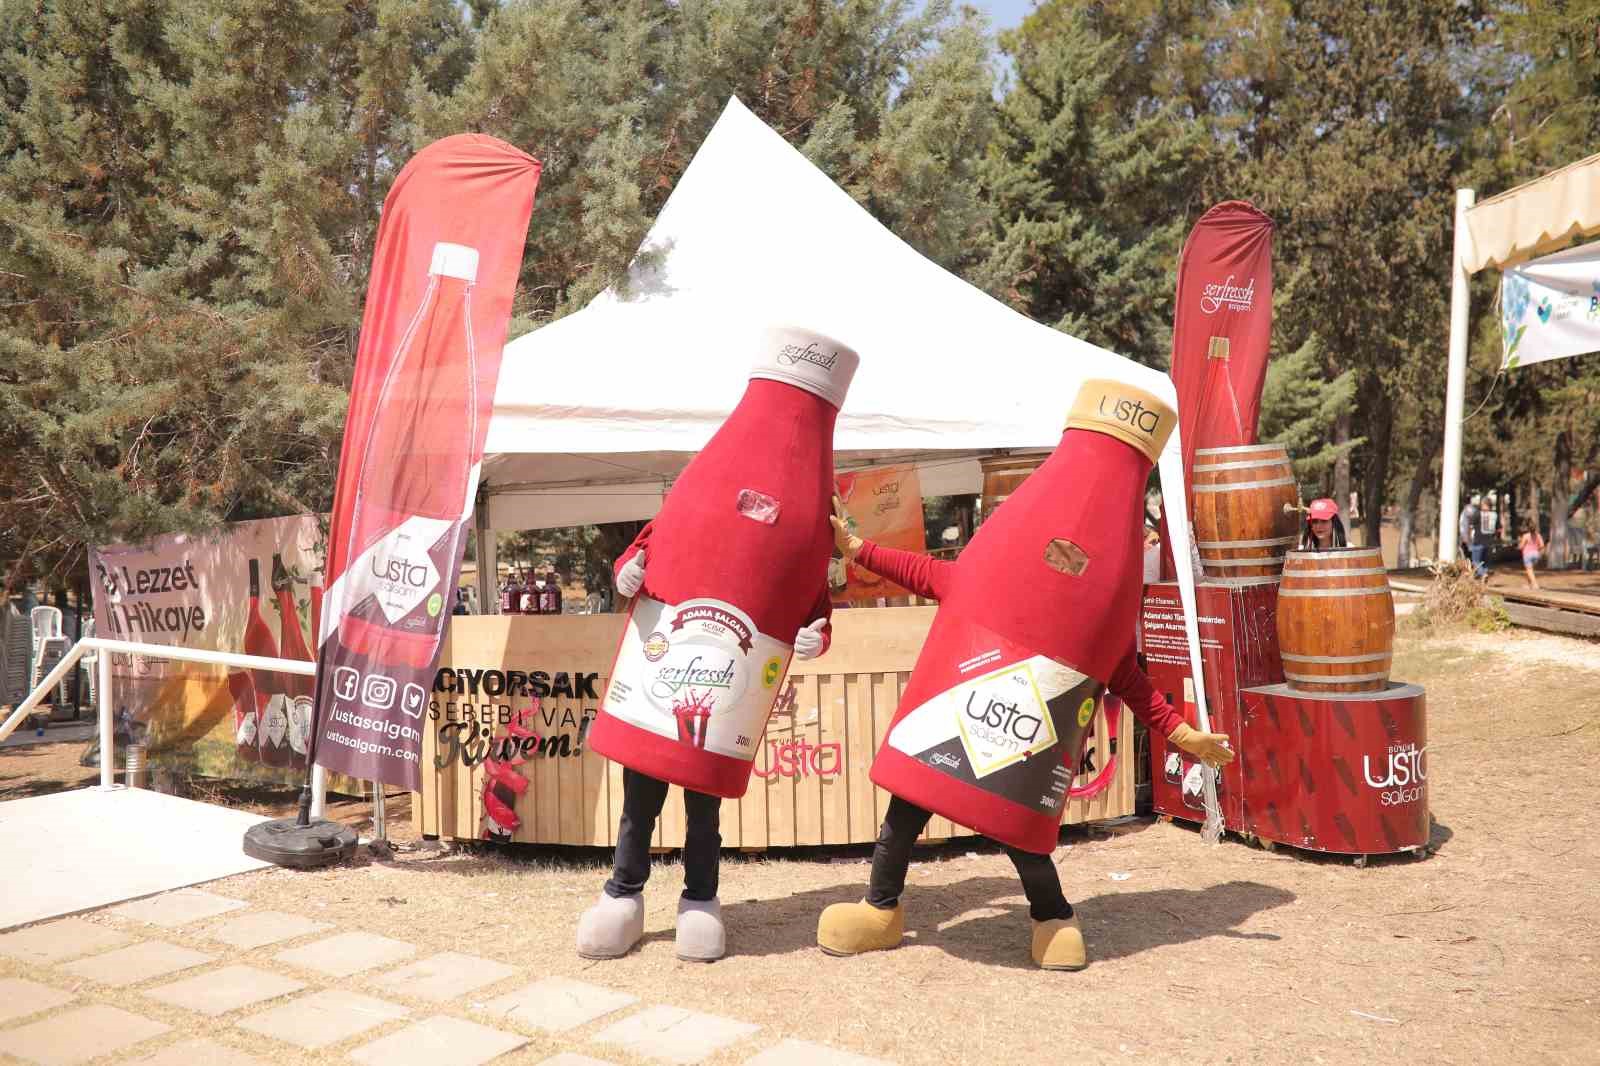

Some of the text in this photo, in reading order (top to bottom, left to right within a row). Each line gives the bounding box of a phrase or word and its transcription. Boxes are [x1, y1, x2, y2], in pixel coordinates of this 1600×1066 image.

[122, 559, 199, 595] Lezzet
[122, 600, 206, 642] Hikaye
[966, 690, 1042, 744] usta
